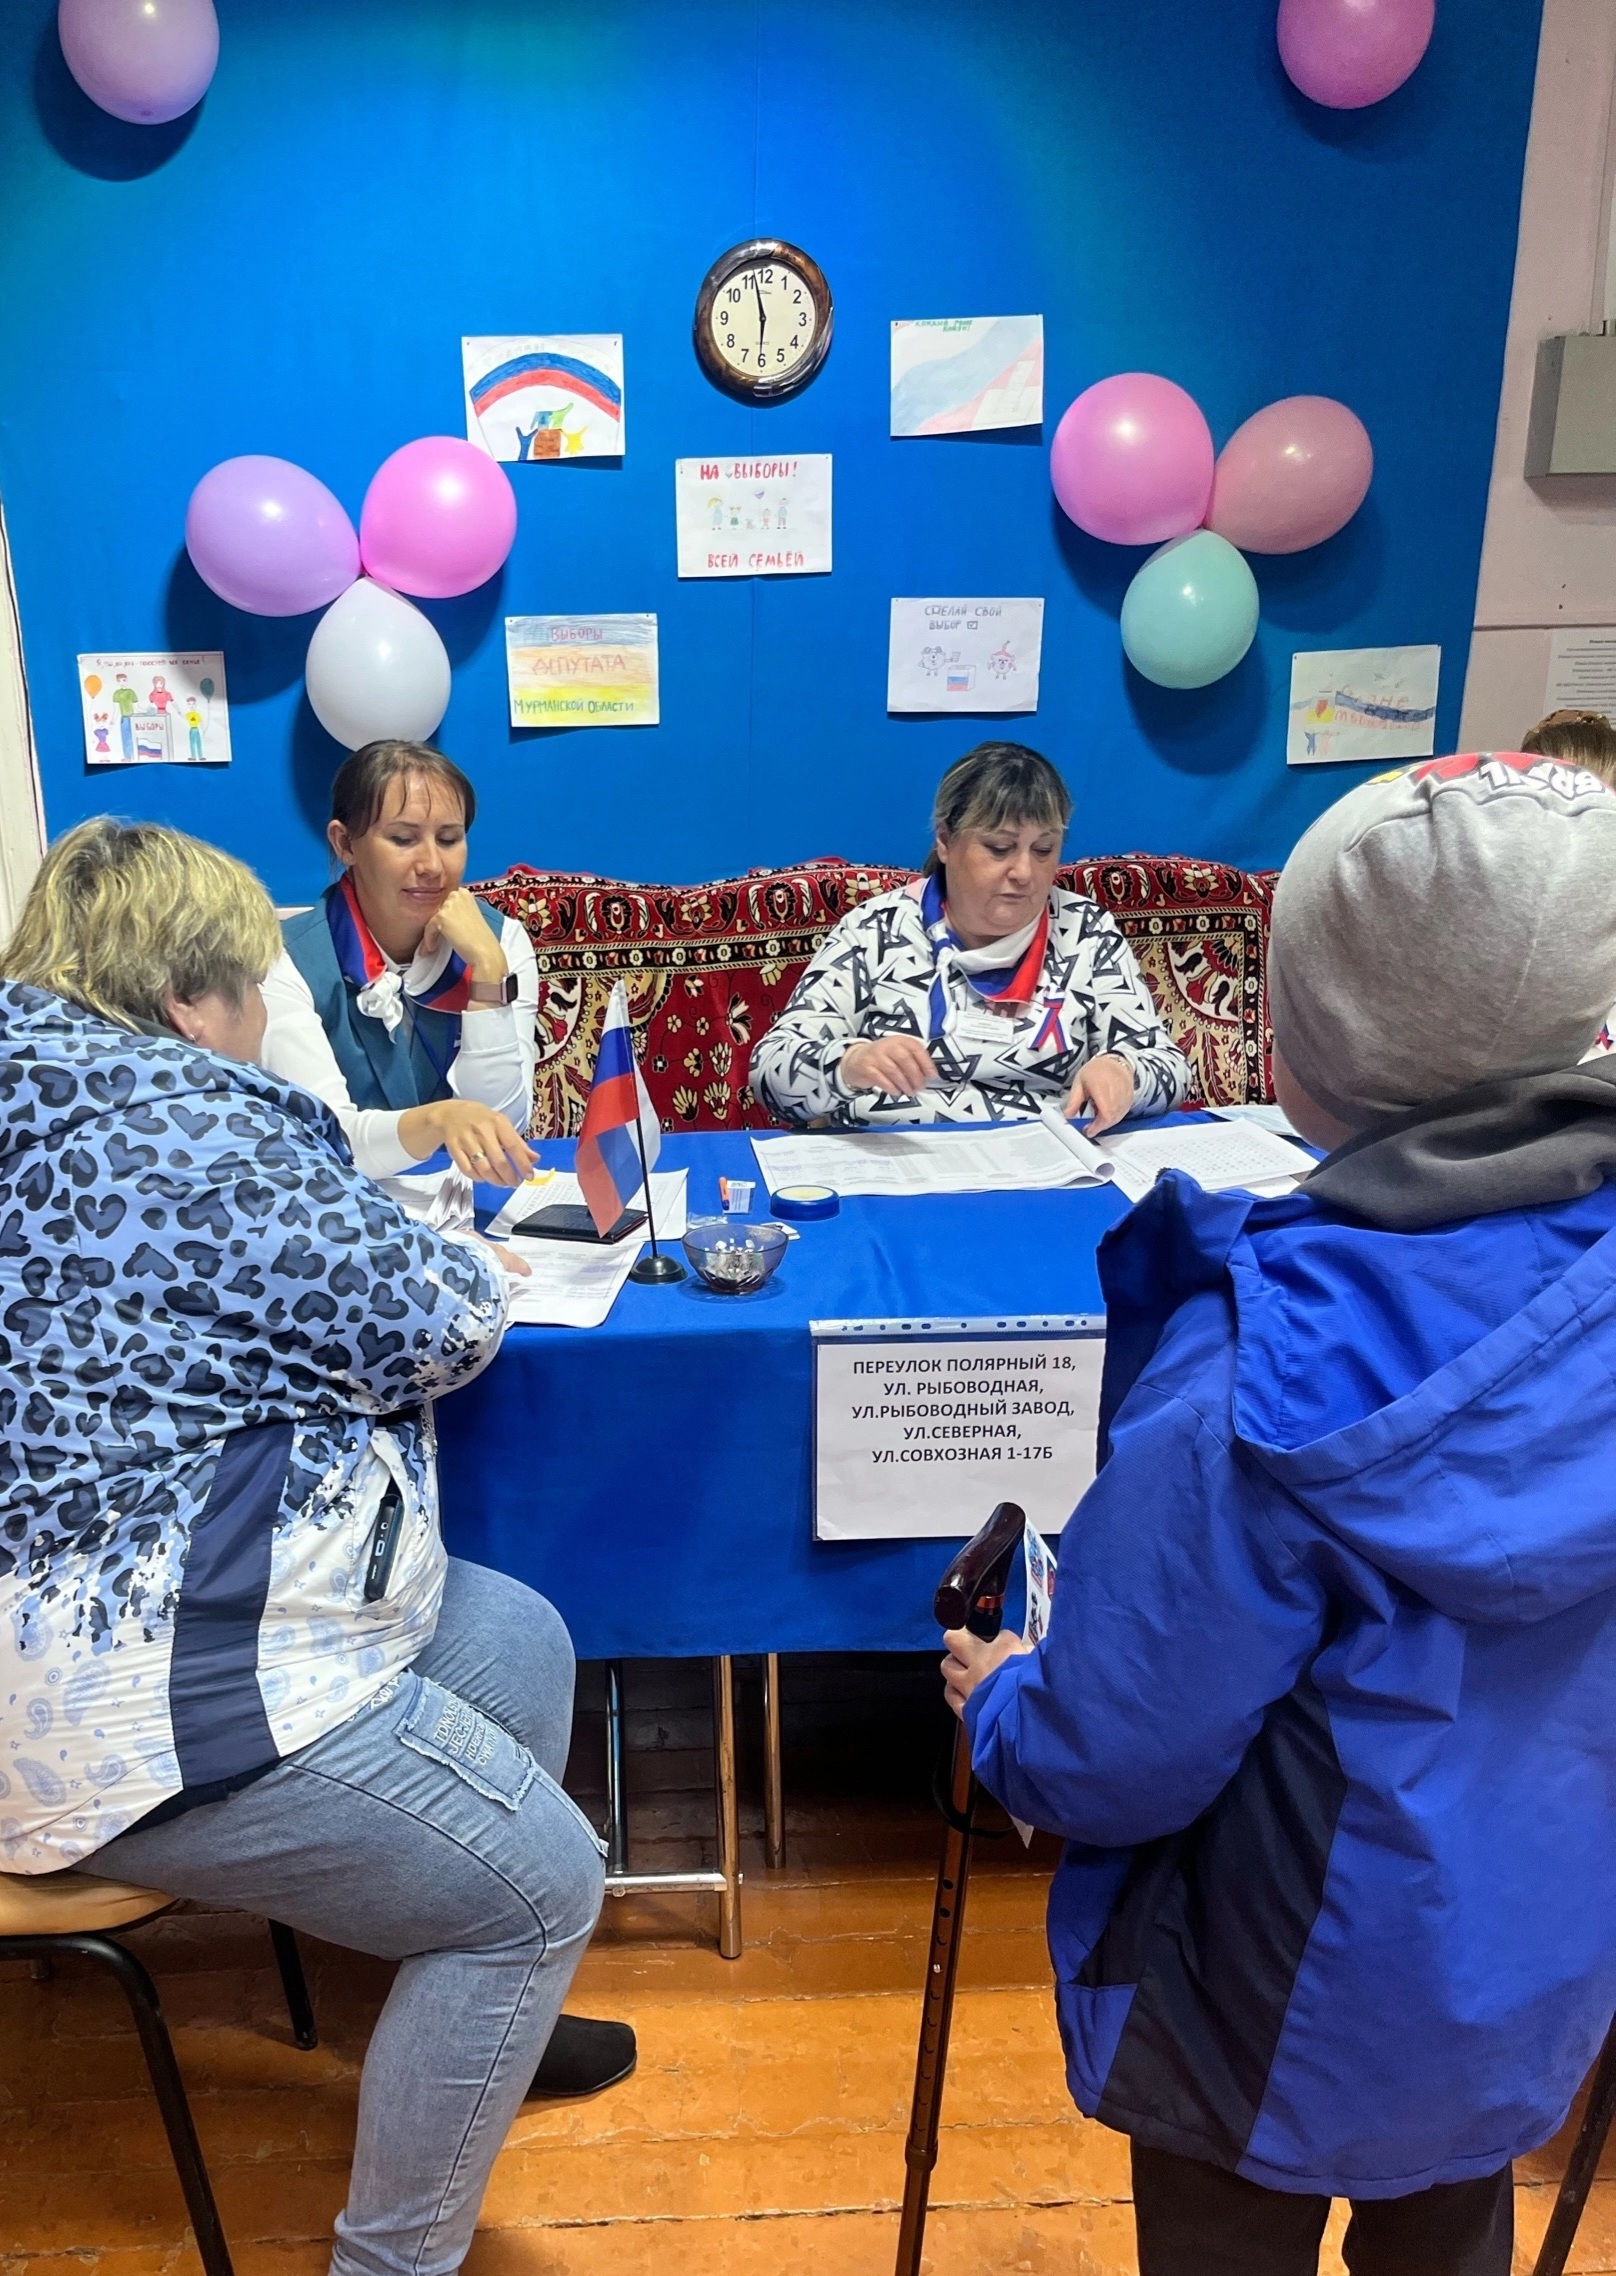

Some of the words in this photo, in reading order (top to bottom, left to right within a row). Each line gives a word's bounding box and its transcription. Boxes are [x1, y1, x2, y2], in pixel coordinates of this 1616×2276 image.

[742, 275, 754, 290] 11
[758, 269, 773, 284] 12
[781, 276, 788, 290] 1
[726, 288, 741, 303] 10
[793, 289, 802, 304] 2
[720, 311, 729, 325] 9
[798, 312, 807, 326] 3
[726, 334, 735, 348] 8
[790, 335, 799, 349] 4
[741, 349, 749, 363] 7
[757, 354, 766, 367] 6
[776, 349, 785, 362] 5
[700, 464, 720, 480] НА
[734, 461, 798, 479] ВЫБОРЫ!
[551, 627, 604, 641] ВЫБОРЫ
[532, 654, 627, 675] ДЕПУТАТА
[135, 722, 165, 731] ВЫБОРЫ
[853, 1359, 942, 1374] ПЕРЕУЛОК
[947, 1354, 1047, 1371] ПОЛЯРНЫЙ
[1052, 1356, 1076, 1371] 18,
[884, 1383, 911, 1396] УЛ.
[917, 1379, 1044, 1396] РЫБОВОДНАЯ,
[852, 1400, 1007, 1419] УЛ.РЫБОВОДНЫЙ
[1012, 1401, 1075, 1417] ЗАВОД,
[904, 1425, 1022, 1440] УЛ.СЕВЕРНАЯ,
[872, 1447, 1001, 1463] УЛ.СОВХОЗНАЯ
[1007, 1447, 1053, 1460] 1-17Б
